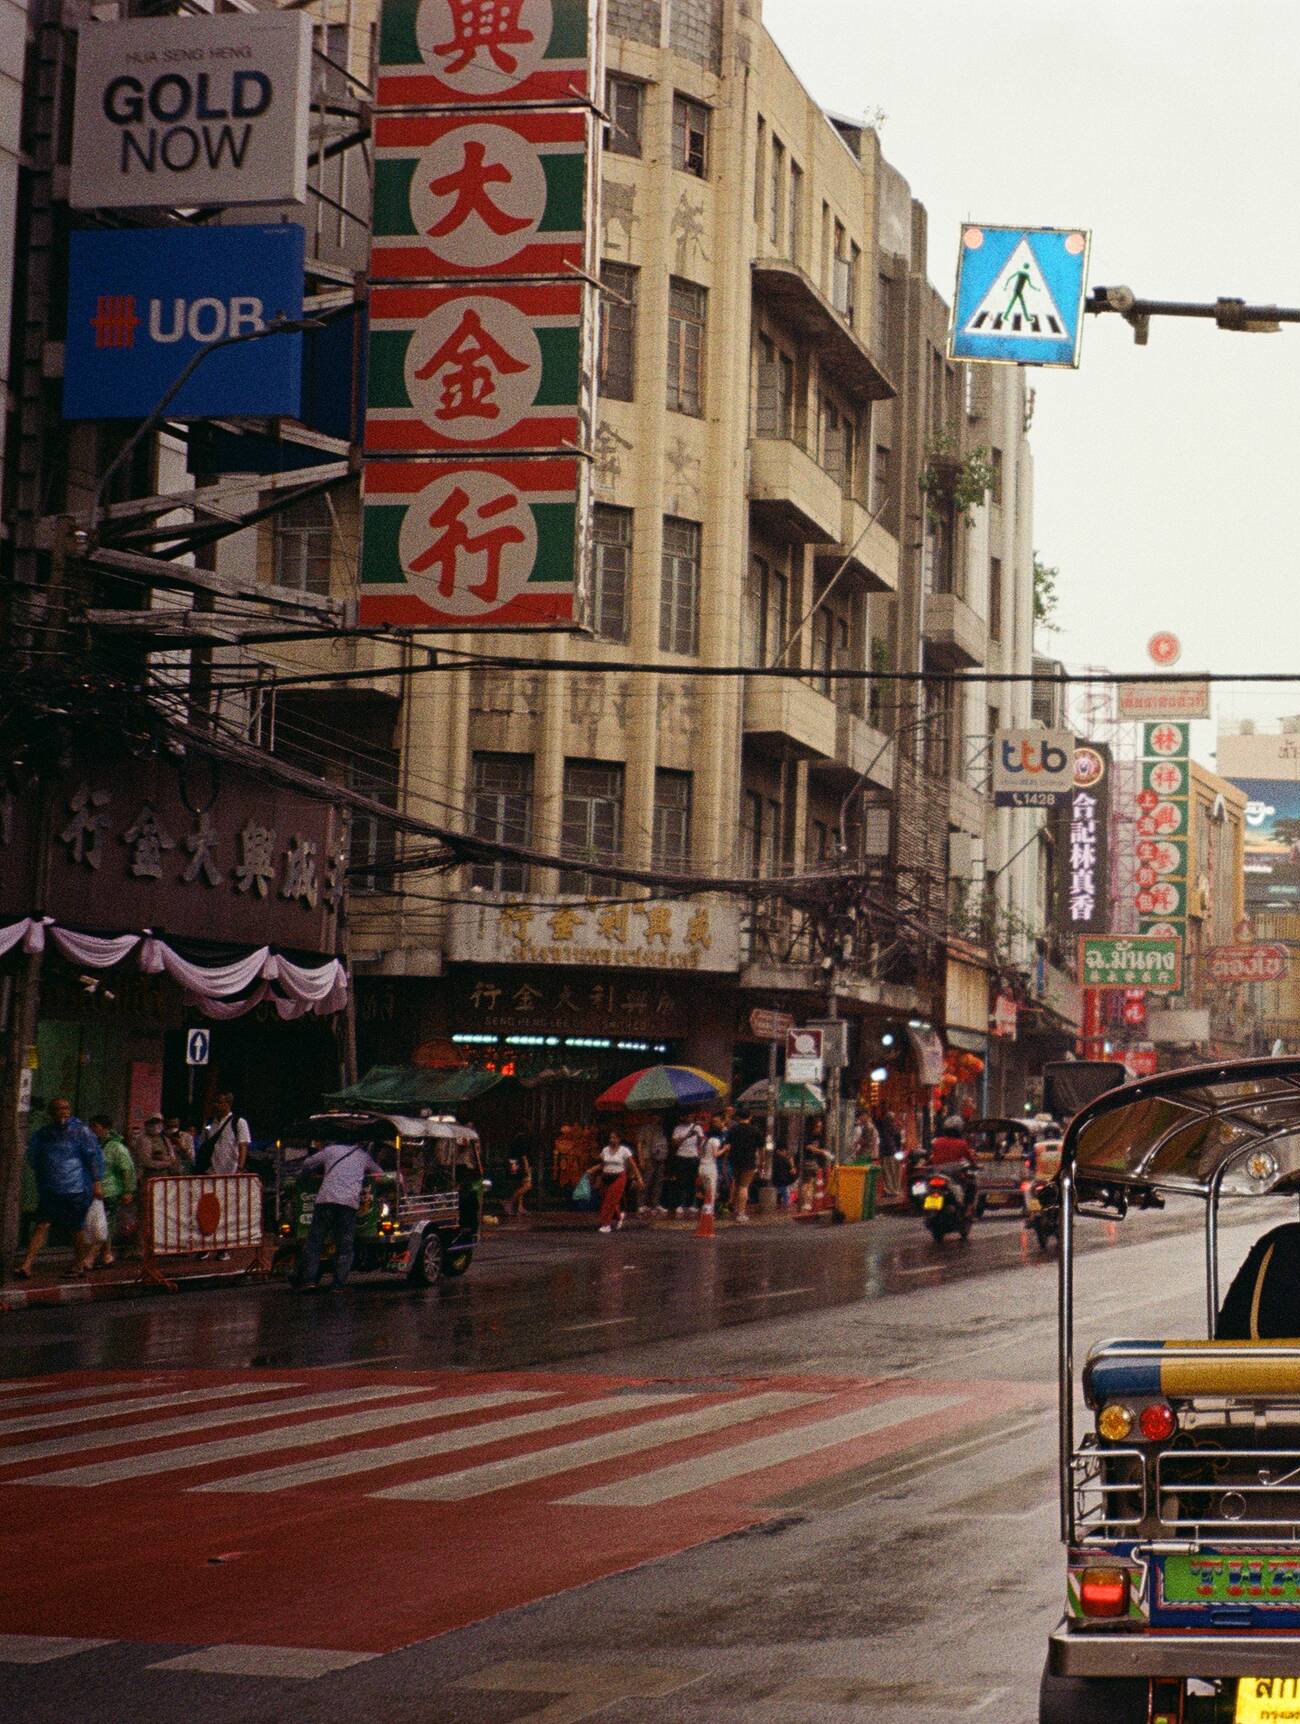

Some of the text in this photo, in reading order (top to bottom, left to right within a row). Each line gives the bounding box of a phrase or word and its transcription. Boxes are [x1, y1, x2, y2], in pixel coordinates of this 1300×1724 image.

[126, 46, 252, 64] HUA SENG HENG
[104, 70, 272, 124] GOLD
[121, 124, 252, 173] NOW
[149, 297, 265, 343] UOB
[1002, 739, 1067, 773] ttb
[1025, 793, 1056, 805] 1428
[1069, 792, 1097, 921] 合記林真香
